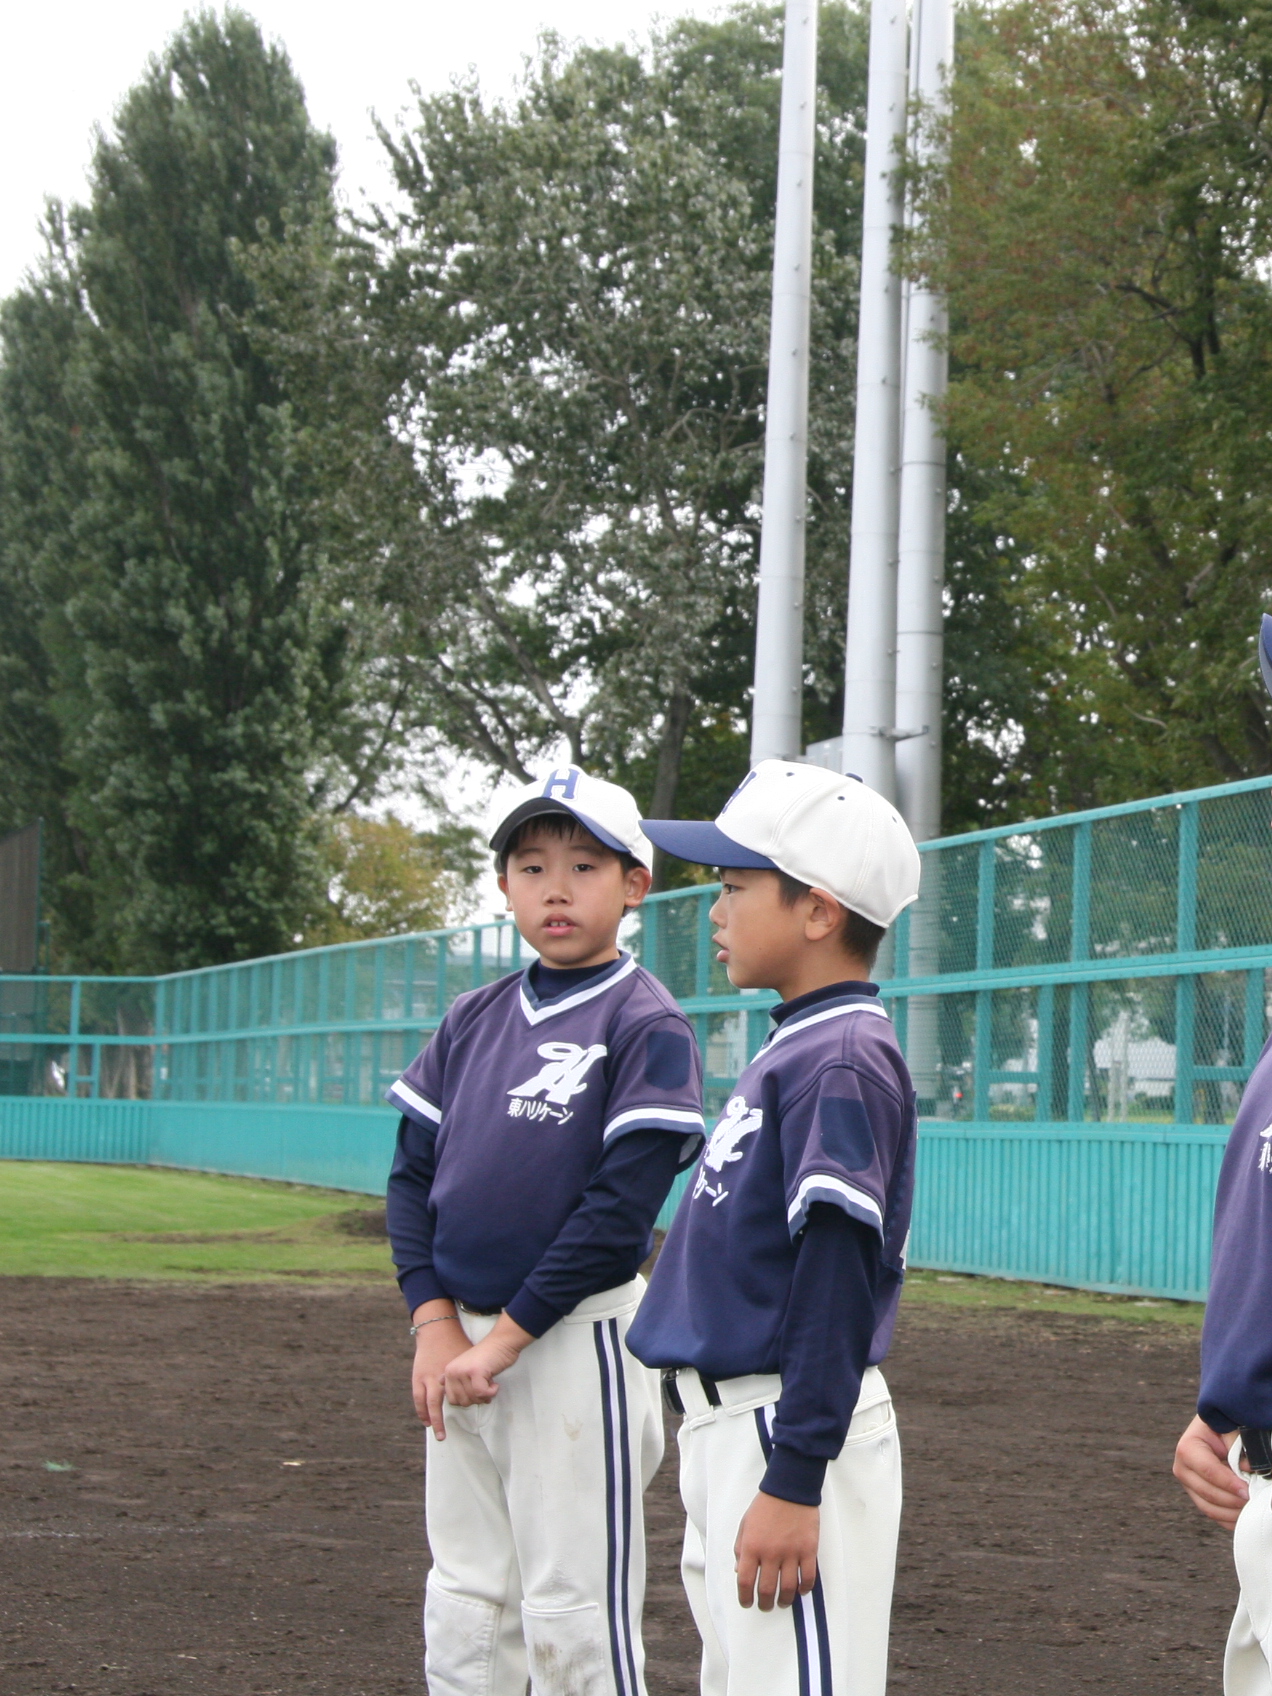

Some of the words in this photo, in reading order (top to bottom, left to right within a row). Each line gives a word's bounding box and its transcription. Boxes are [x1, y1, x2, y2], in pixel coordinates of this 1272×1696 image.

[541, 768, 580, 799] H
[507, 1097, 574, 1125] 東ハリケーン
